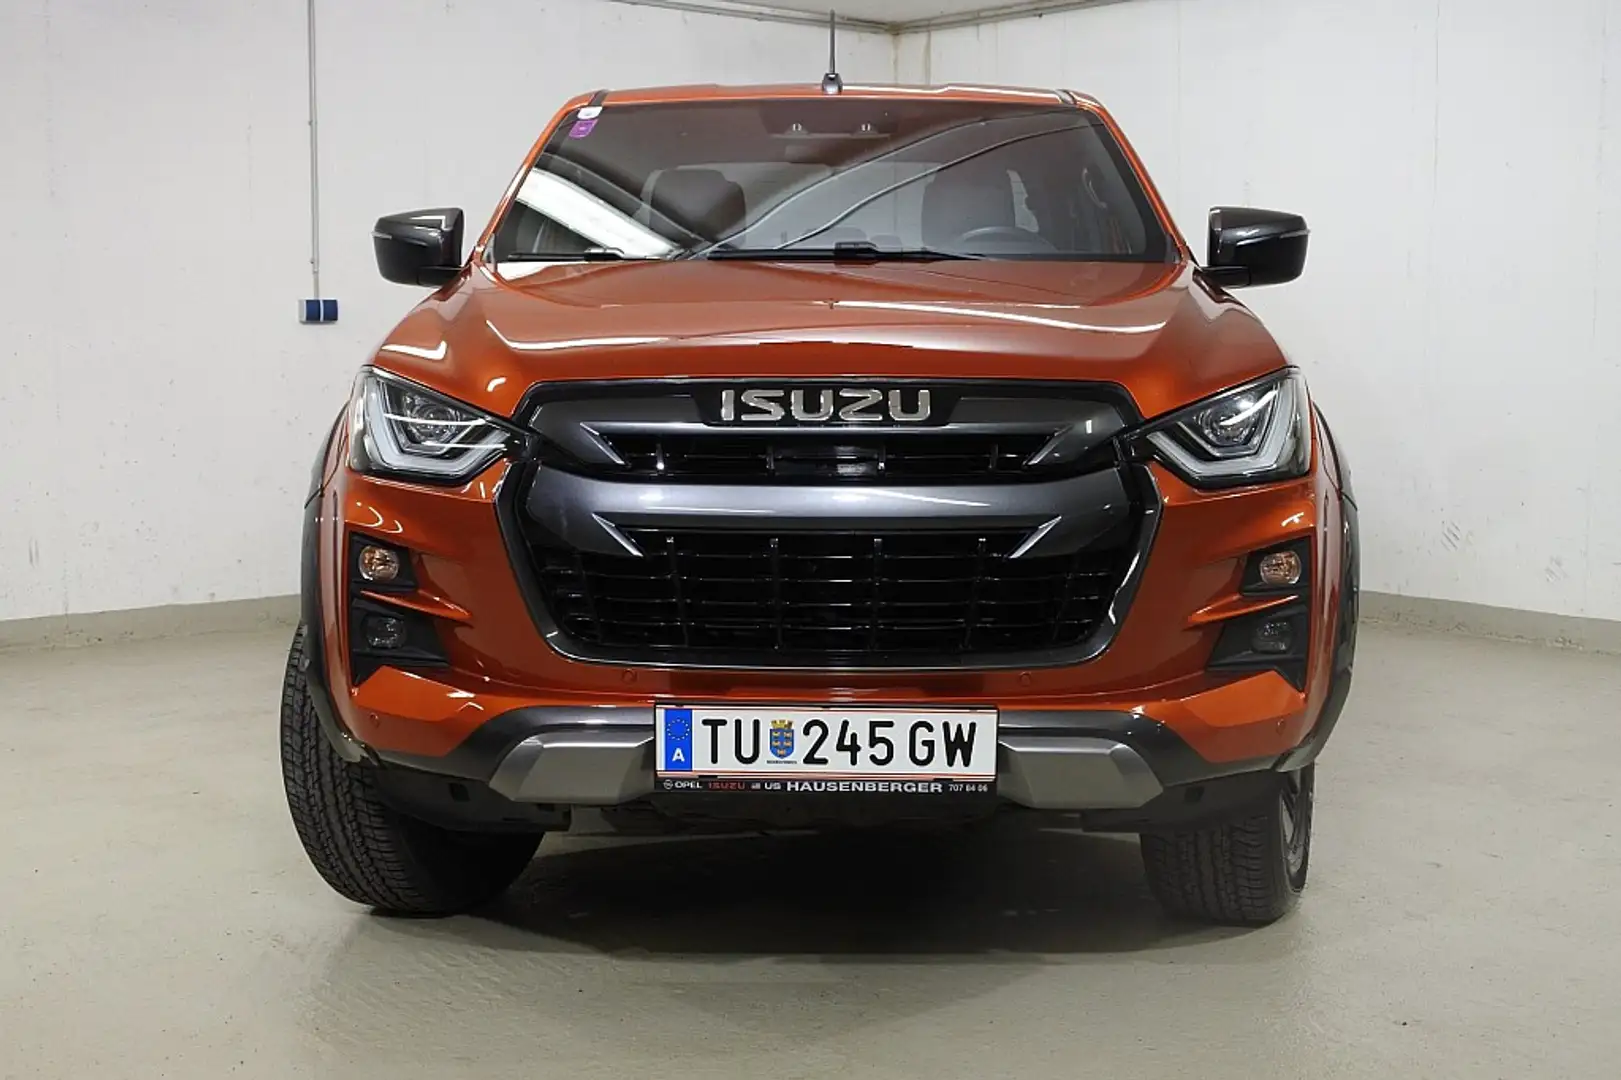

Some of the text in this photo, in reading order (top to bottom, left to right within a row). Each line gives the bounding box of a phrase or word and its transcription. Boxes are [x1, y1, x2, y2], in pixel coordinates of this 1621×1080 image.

[721, 389, 931, 421] ISUZU
[672, 747, 685, 762] A
[701, 718, 977, 768] TU 245 GW
[675, 781, 702, 789] OPEL
[709, 781, 746, 790] ISUZU
[786, 781, 943, 792] HAUSENBERGER
